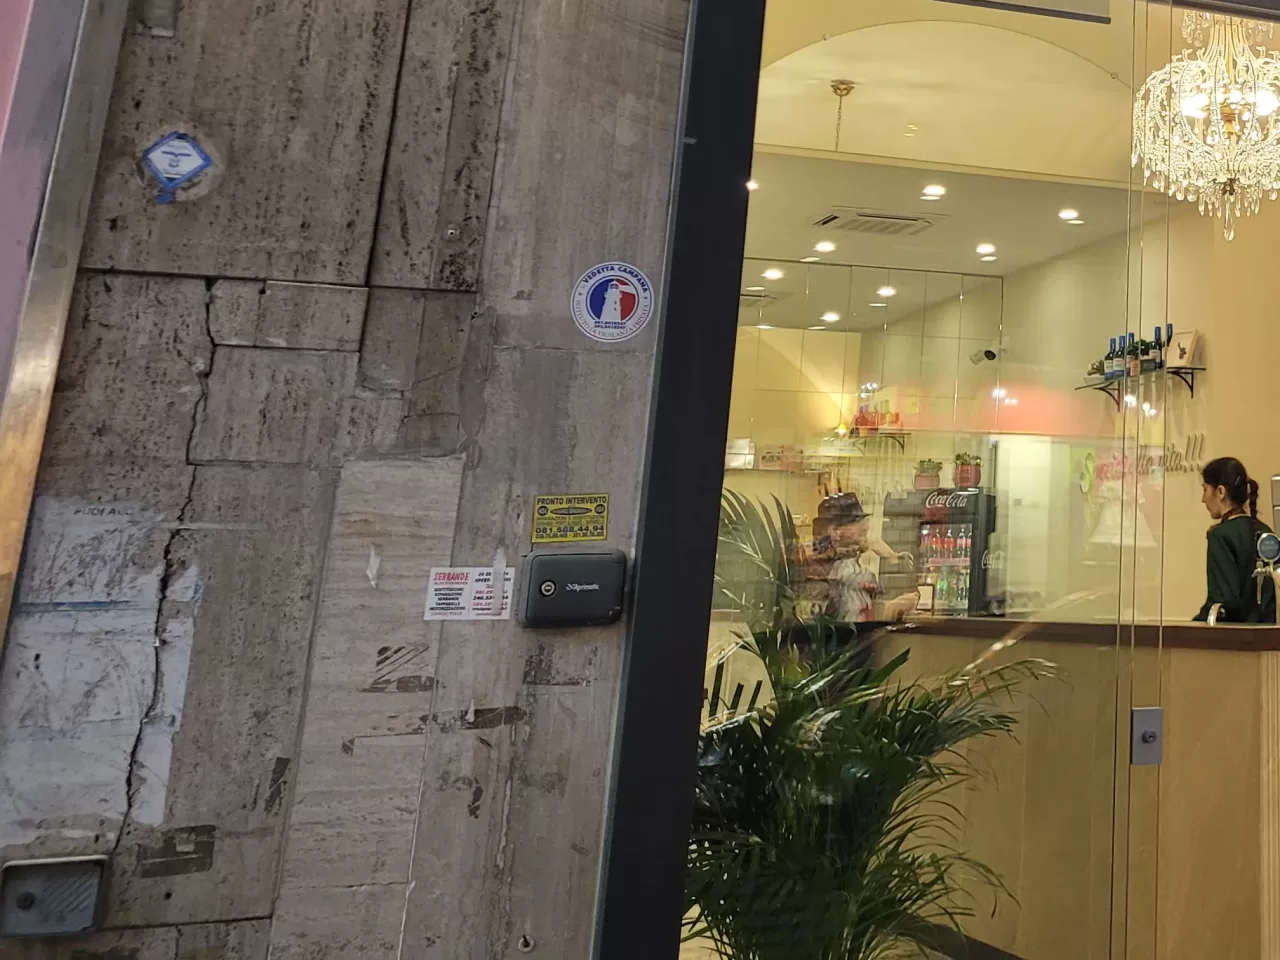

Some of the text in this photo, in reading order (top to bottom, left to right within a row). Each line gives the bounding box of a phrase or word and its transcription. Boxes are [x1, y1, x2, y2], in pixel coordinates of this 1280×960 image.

[583, 266, 649, 293] VEDETTA CAMPANA
[537, 496, 607, 506] PRONTO INTERVENTO
[433, 572, 470, 581] SERRANDE
